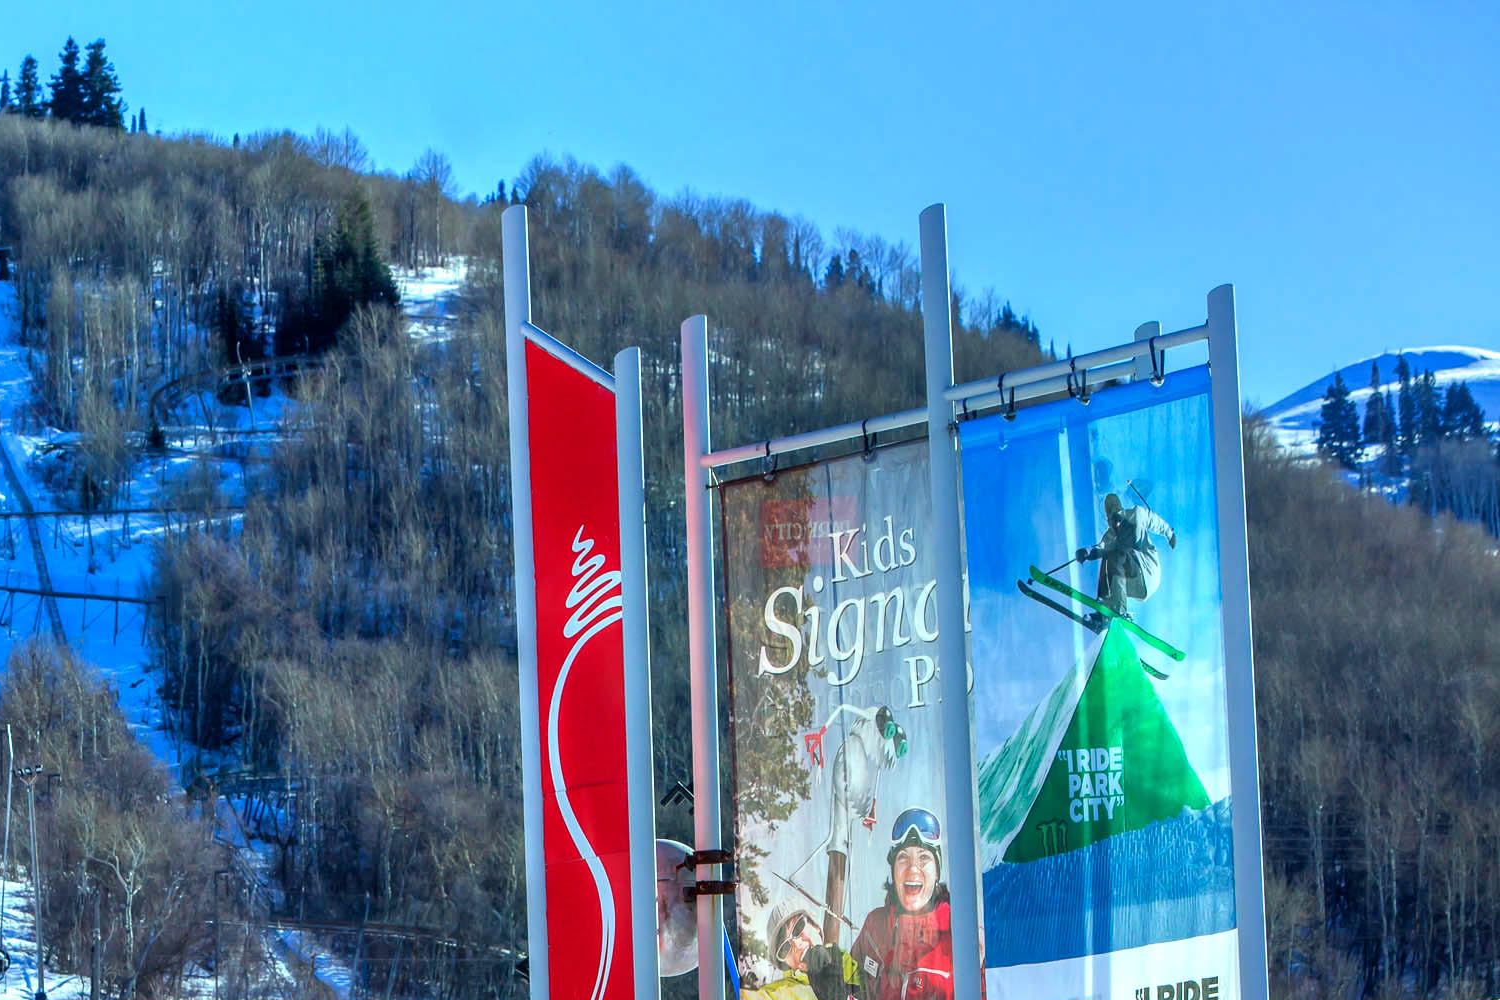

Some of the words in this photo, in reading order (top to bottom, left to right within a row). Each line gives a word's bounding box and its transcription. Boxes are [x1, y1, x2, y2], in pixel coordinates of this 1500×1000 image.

[828, 515, 917, 583] Kids
[1077, 747, 1123, 772] RIDE
[1069, 771, 1125, 798] PARK
